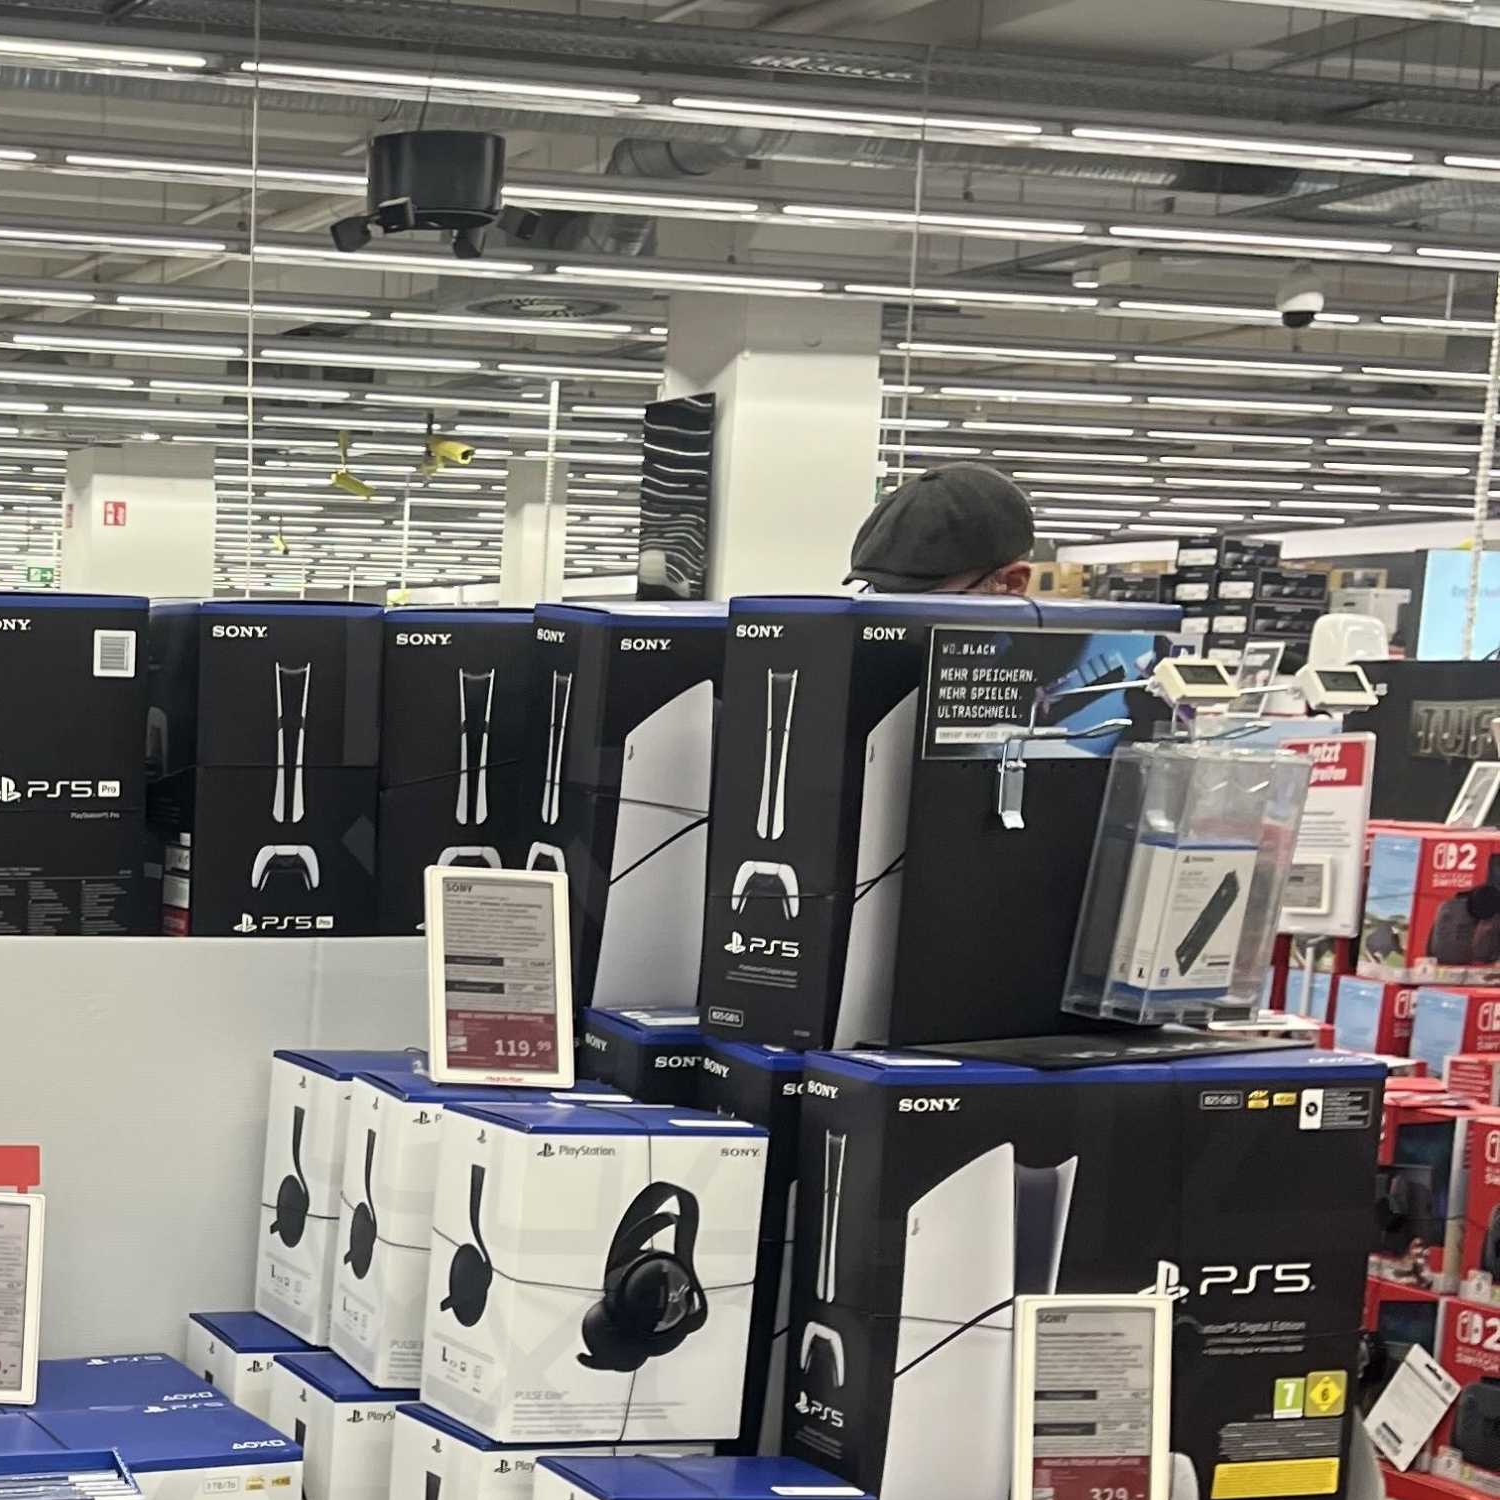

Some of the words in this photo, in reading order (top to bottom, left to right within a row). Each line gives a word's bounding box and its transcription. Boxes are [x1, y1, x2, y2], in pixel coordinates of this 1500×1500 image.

[212, 625, 268, 638] SONY
[537, 628, 566, 643] SONY
[736, 625, 784, 638] SONY
[863, 627, 907, 641] SONY
[396, 633, 452, 645] SONY
[620, 638, 671, 651] SONY
[942, 644, 997, 655] WD_BLACK
[940, 668, 968, 682] MEHR
[972, 668, 1038, 682] SPEICHERN.
[938, 687, 966, 699] MEHR
[970, 687, 1023, 701] SPIELEN.
[937, 705, 1024, 719] ULTRASCHNELL.
[27, 780, 94, 798] PS5
[101, 784, 117, 794] Pro
[1458, 844, 1477, 870] 2
[262, 916, 312, 930] PS5
[749, 937, 800, 958] PS5
[584, 1032, 609, 1052] SONY
[655, 1056, 701, 1068] SON
[703, 1057, 731, 1078] SONY
[807, 1080, 839, 1099] SONY
[898, 1098, 960, 1112] SONY
[559, 1145, 616, 1157] PlayStation
[720, 1147, 760, 1157] SONY
[1200, 1263, 1312, 1295] PS5
[1284, 1382, 1297, 1407] 7
[810, 1400, 844, 1428] PS5
